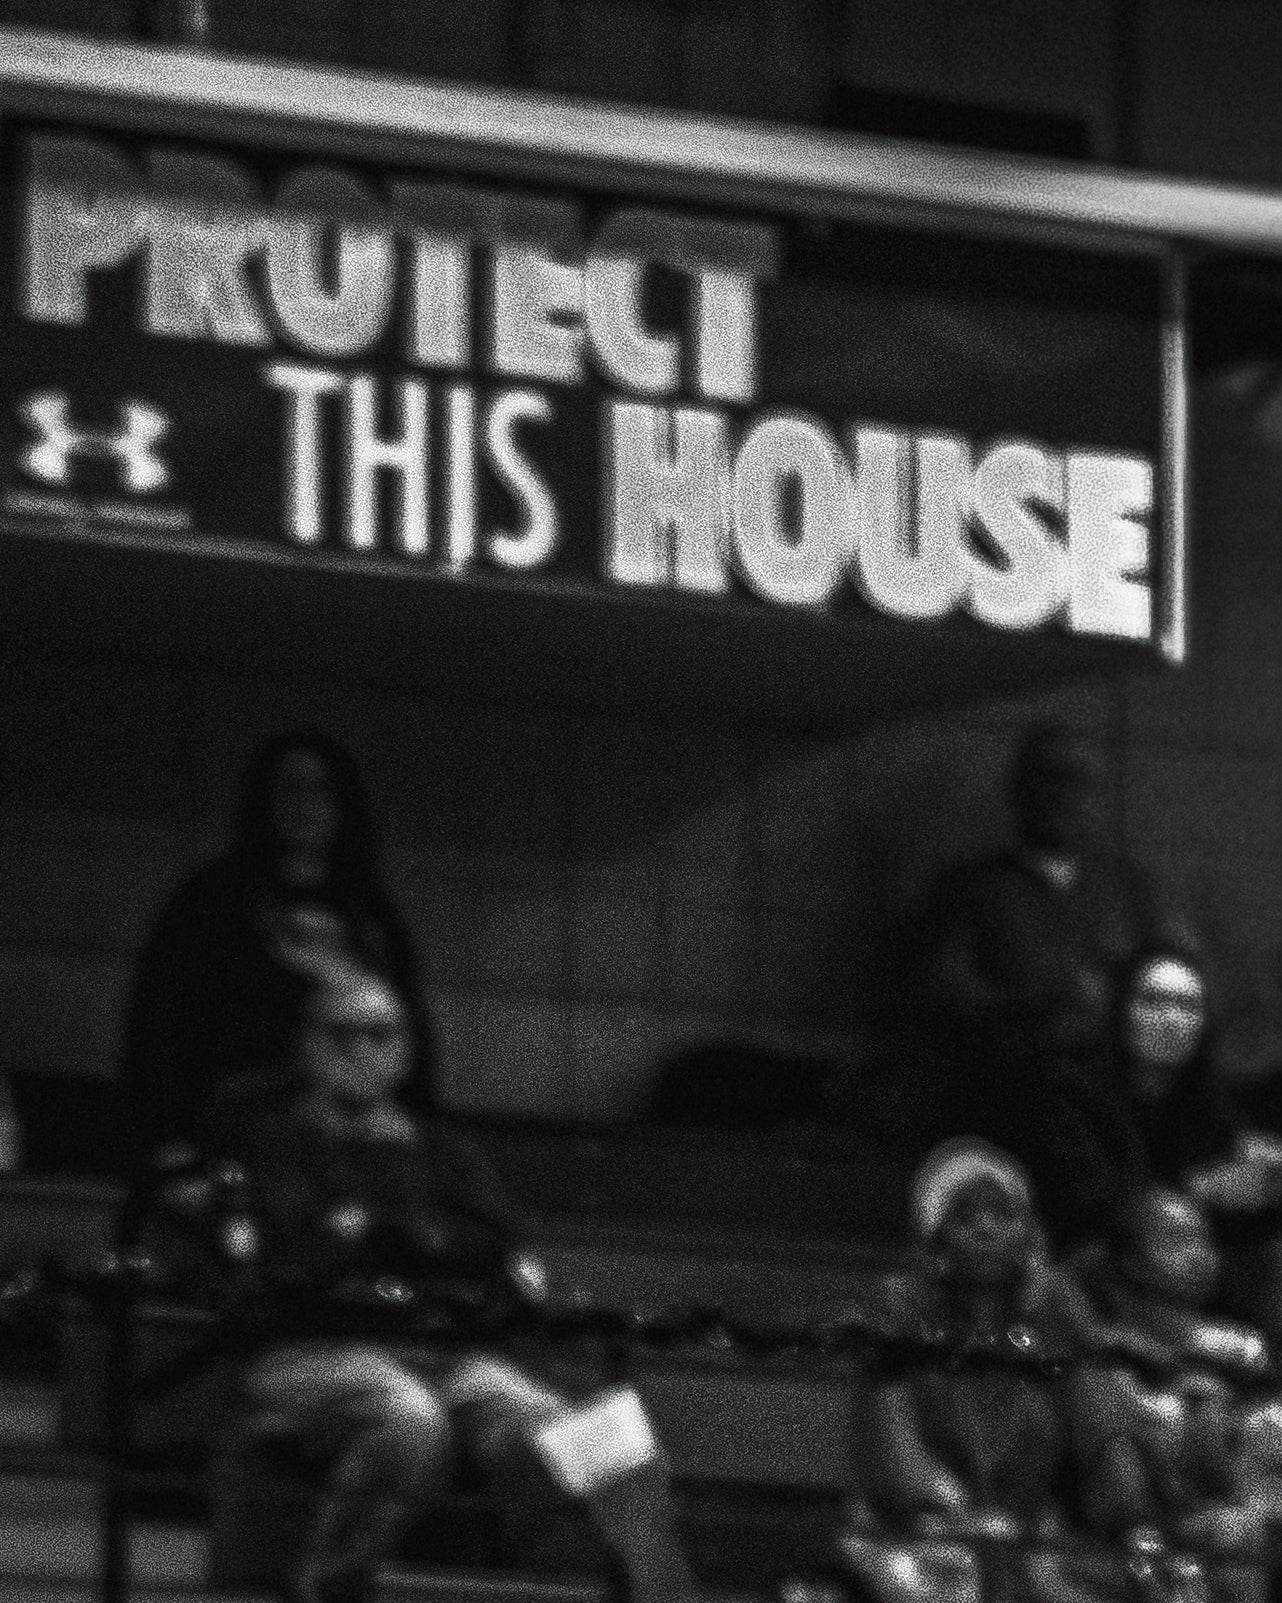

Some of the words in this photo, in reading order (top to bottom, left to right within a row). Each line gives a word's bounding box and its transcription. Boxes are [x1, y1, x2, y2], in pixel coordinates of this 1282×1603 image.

[15, 132, 785, 402] PROTECT
[258, 358, 564, 578] THIS
[606, 398, 1160, 642] HOUSE
